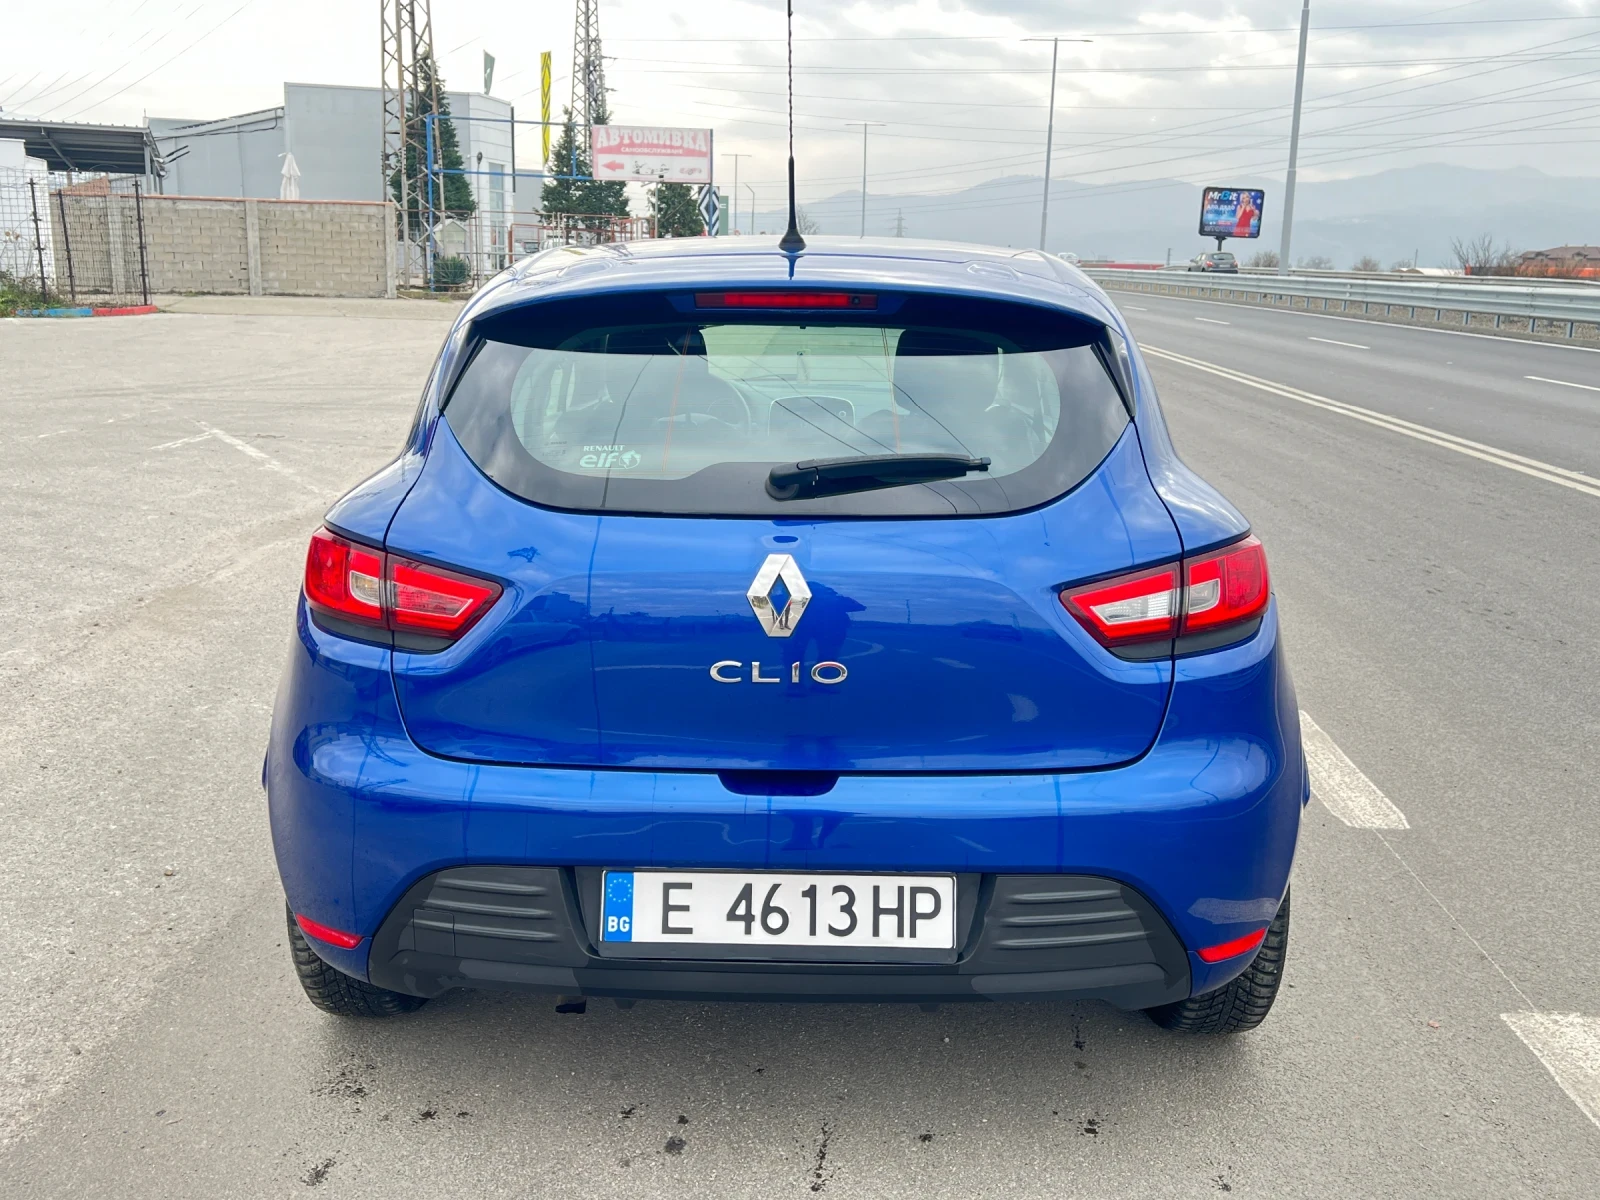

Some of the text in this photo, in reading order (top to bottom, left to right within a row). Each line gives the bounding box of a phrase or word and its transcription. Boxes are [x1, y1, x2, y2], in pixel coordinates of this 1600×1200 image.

[597, 127, 707, 152] АВТОМИВКА
[580, 452, 619, 468] elf
[709, 660, 848, 684] CLIO
[661, 882, 942, 939] E 4613 HP
[607, 915, 630, 932] BG
